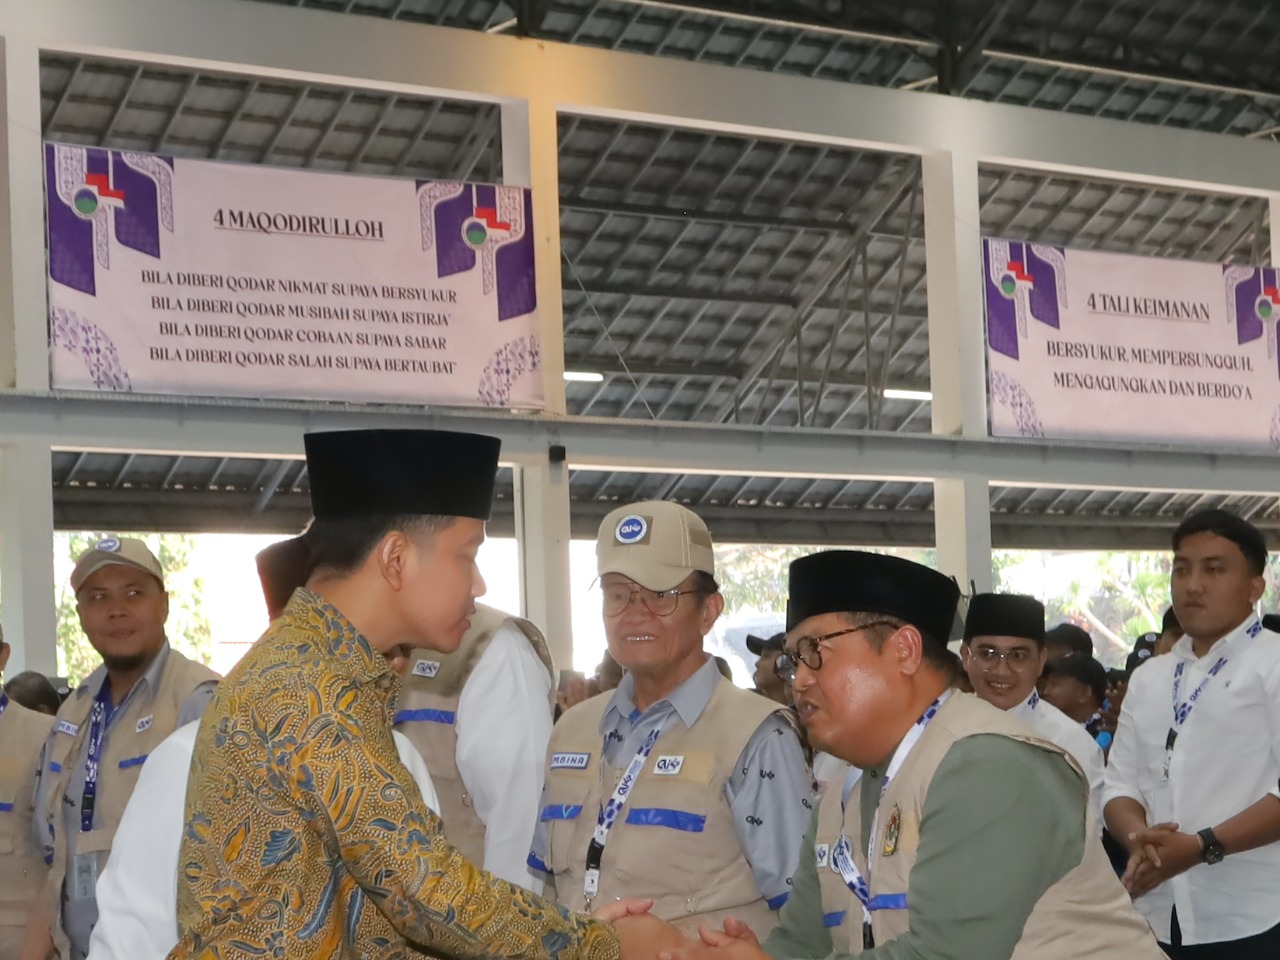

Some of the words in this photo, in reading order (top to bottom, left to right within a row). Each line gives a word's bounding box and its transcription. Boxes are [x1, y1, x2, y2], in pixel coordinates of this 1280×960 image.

[213, 208, 224, 226] 4
[228, 209, 384, 238] MAQODIRULLOH
[141, 270, 173, 285] BILA
[176, 272, 223, 288] DIBERI
[226, 275, 275, 292] QODAR
[278, 279, 328, 295] NIKMAT
[332, 282, 378, 298] SUPAYA
[381, 285, 457, 303] BERSYUKUR
[151, 295, 183, 311] BILA
[187, 298, 233, 314] DIBERI
[236, 301, 285, 318] QODAR
[288, 304, 349, 320] MUSIBAH
[353, 308, 399, 324] SUPAYA
[1087, 292, 1096, 310] 4
[1099, 294, 1130, 314] TALI
[1133, 297, 1210, 321] KEIMANAN
[159, 321, 191, 337] BILA
[194, 323, 241, 339] DIBERI
[244, 326, 293, 343] QODAR
[297, 329, 353, 345] COBAAN
[356, 332, 401, 348] SUPAYA
[404, 335, 447, 350] SABAR
[150, 346, 182, 361] BILA
[186, 348, 232, 364] DIBERI
[235, 351, 285, 368] QODAR
[288, 353, 332, 369] SALAH
[335, 356, 381, 371] SUPAYA
[384, 358, 457, 374] BERTAUBAT
[1046, 340, 1129, 363] BERSYUKUR,
[1053, 371, 1166, 395] MENGAGUNGKAN
[1169, 379, 1195, 397] DAN
[1197, 381, 1253, 401] BERDO'A
